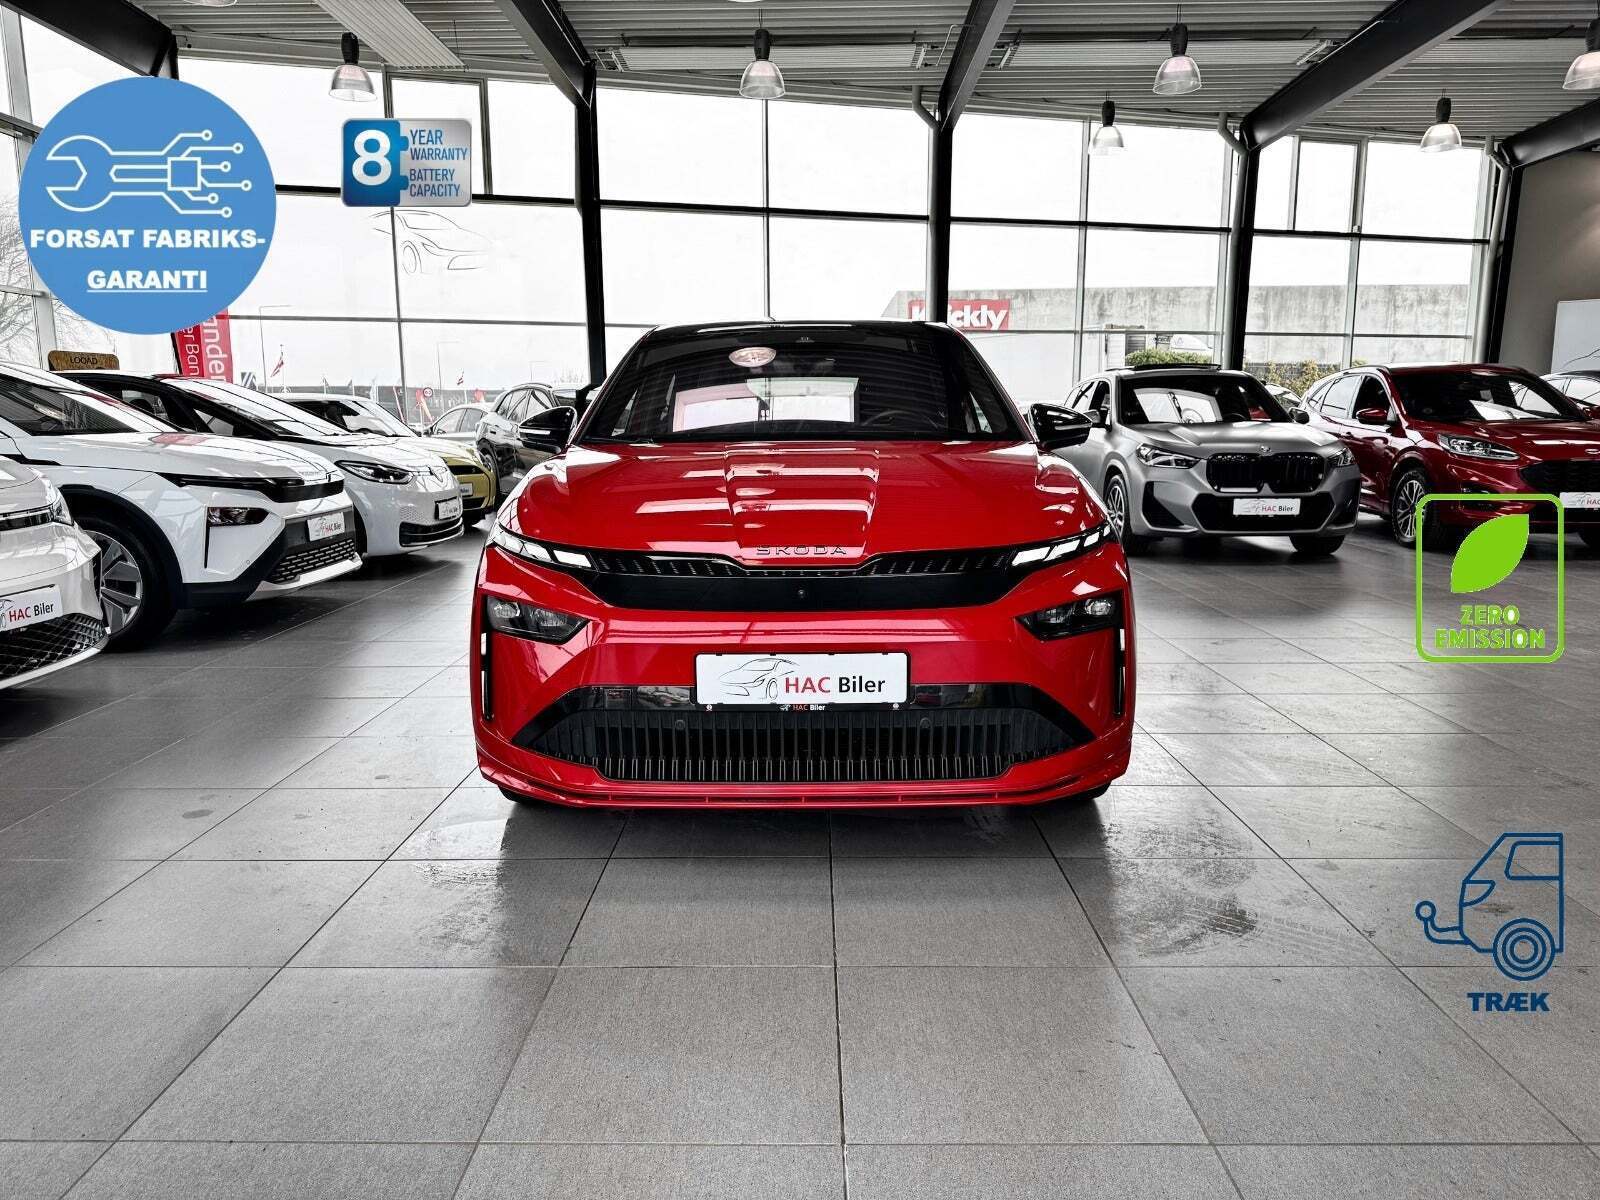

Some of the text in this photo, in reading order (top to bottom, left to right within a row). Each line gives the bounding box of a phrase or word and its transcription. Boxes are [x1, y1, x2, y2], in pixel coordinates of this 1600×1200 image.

[9, 602, 54, 622] HAC Biler
[785, 676, 886, 693] HAC Biler
